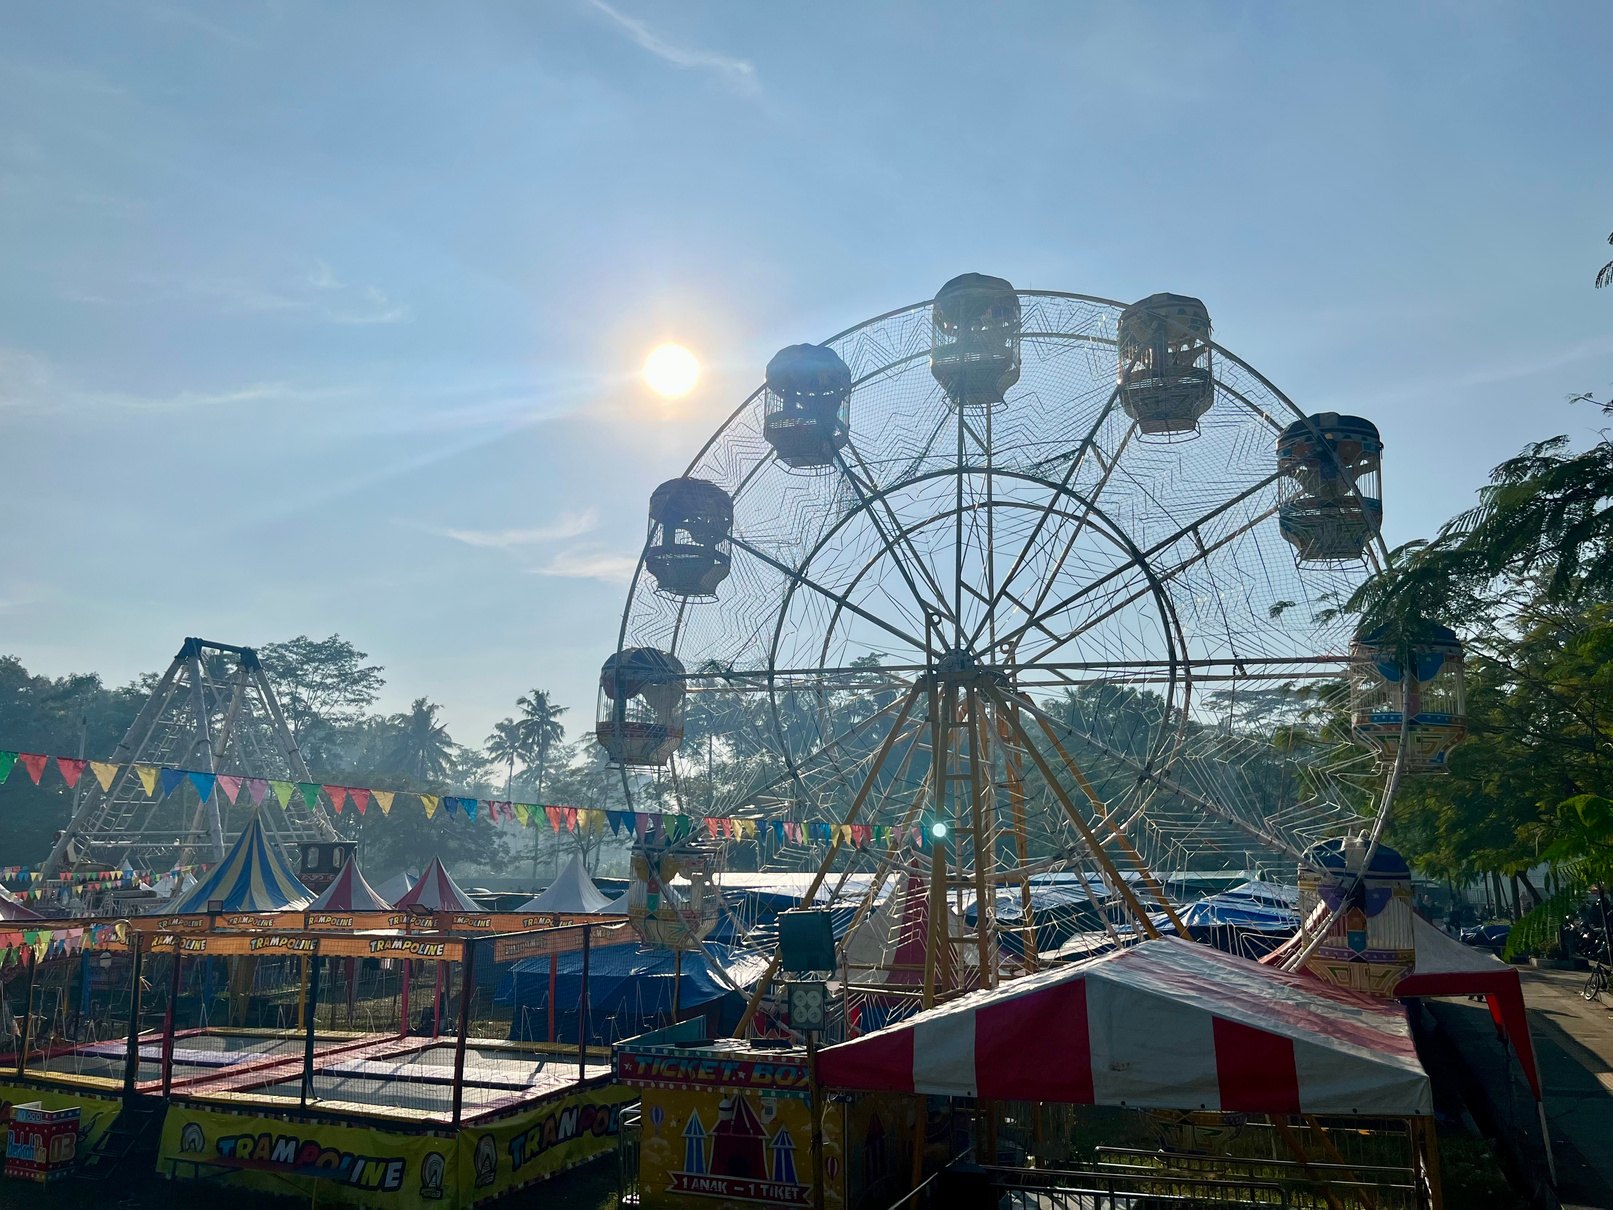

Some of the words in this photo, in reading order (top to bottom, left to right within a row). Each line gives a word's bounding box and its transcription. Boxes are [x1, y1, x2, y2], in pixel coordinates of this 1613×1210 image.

[228, 915, 274, 927] TRAMPOLINE
[307, 915, 353, 927] RAMPOLINE
[523, 916, 574, 928] TRAMPINE
[151, 934, 207, 951] RAMPOLINE
[250, 935, 318, 952] TRAMPOLINE
[369, 939, 445, 956] TRAMPOLINE
[633, 1055, 740, 1082] TICKET
[50, 1132, 77, 1163] 03
[682, 1176, 689, 1189] 1
[691, 1178, 727, 1194] ANAK
[748, 1184, 755, 1196] 1
[760, 1184, 800, 1200] TIKET
